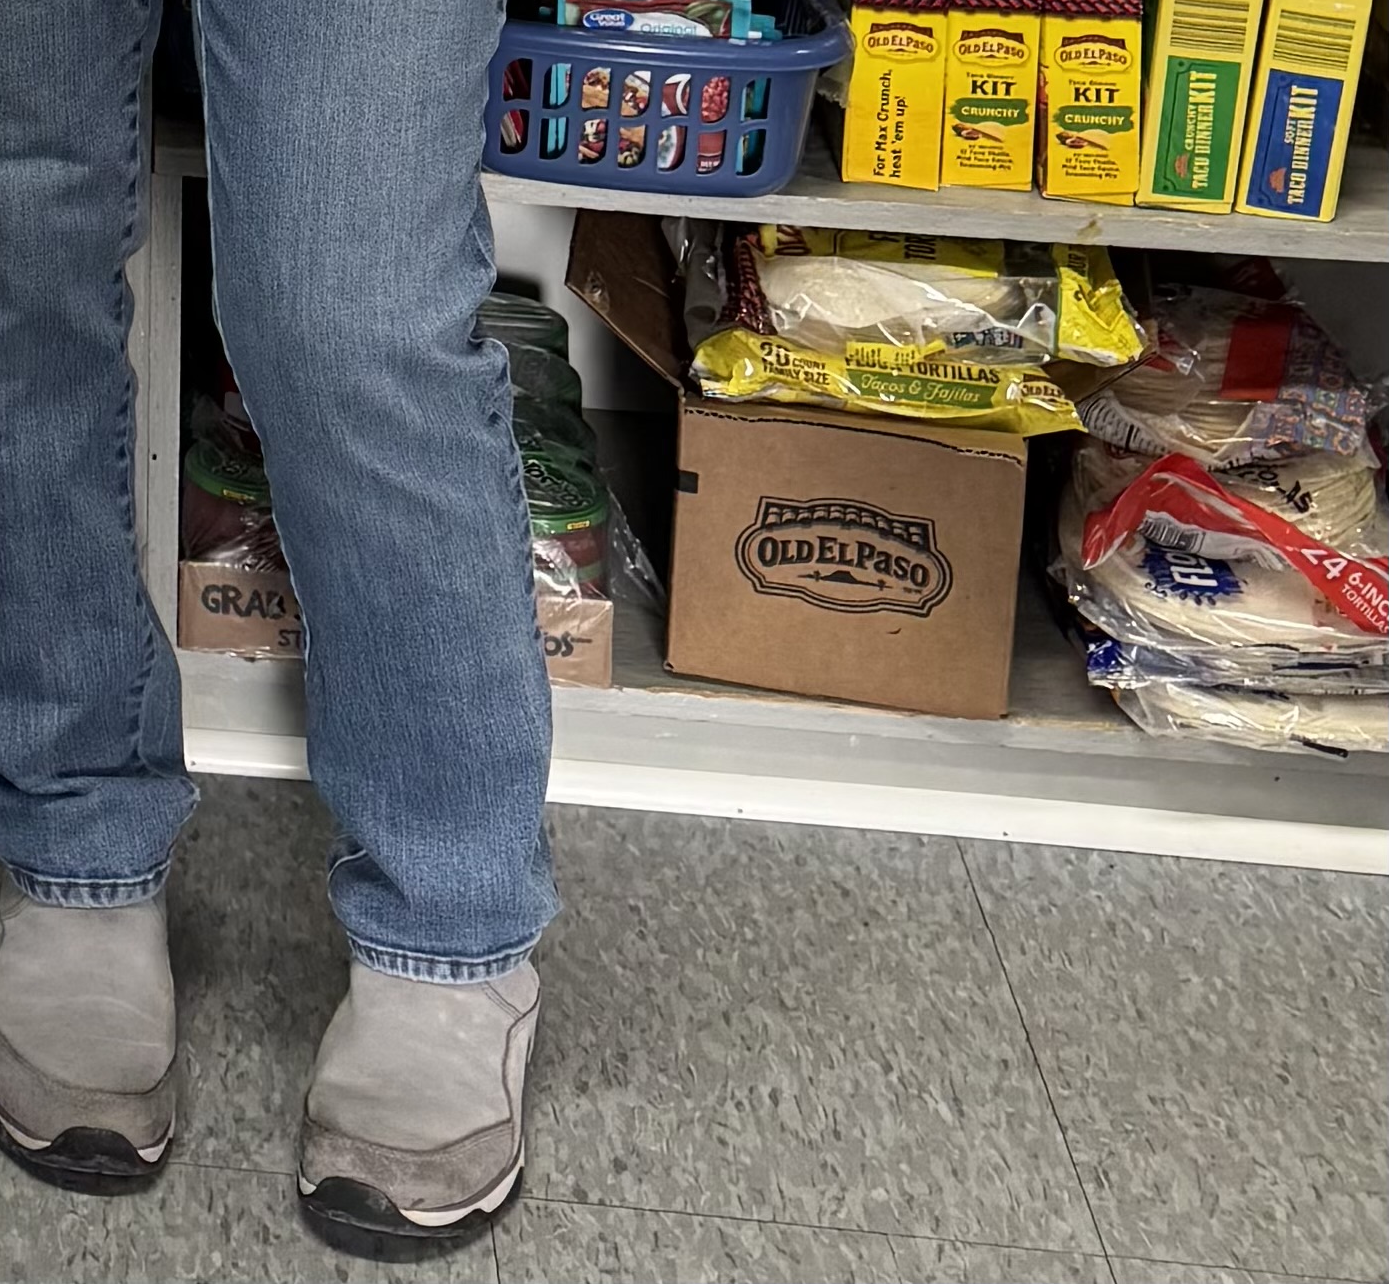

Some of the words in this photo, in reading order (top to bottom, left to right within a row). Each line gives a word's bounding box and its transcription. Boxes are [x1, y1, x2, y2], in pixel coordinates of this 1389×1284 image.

[877, 70, 892, 122] Crunch,
[971, 80, 1017, 96] KIT
[1074, 87, 1120, 103] KIT
[875, 124, 887, 152] Max
[873, 154, 886, 176] For
[890, 149, 900, 178] heat
[860, 371, 904, 395] Tacos
[905, 364, 1001, 386] TORTILLAS
[199, 584, 285, 619] GRAB
